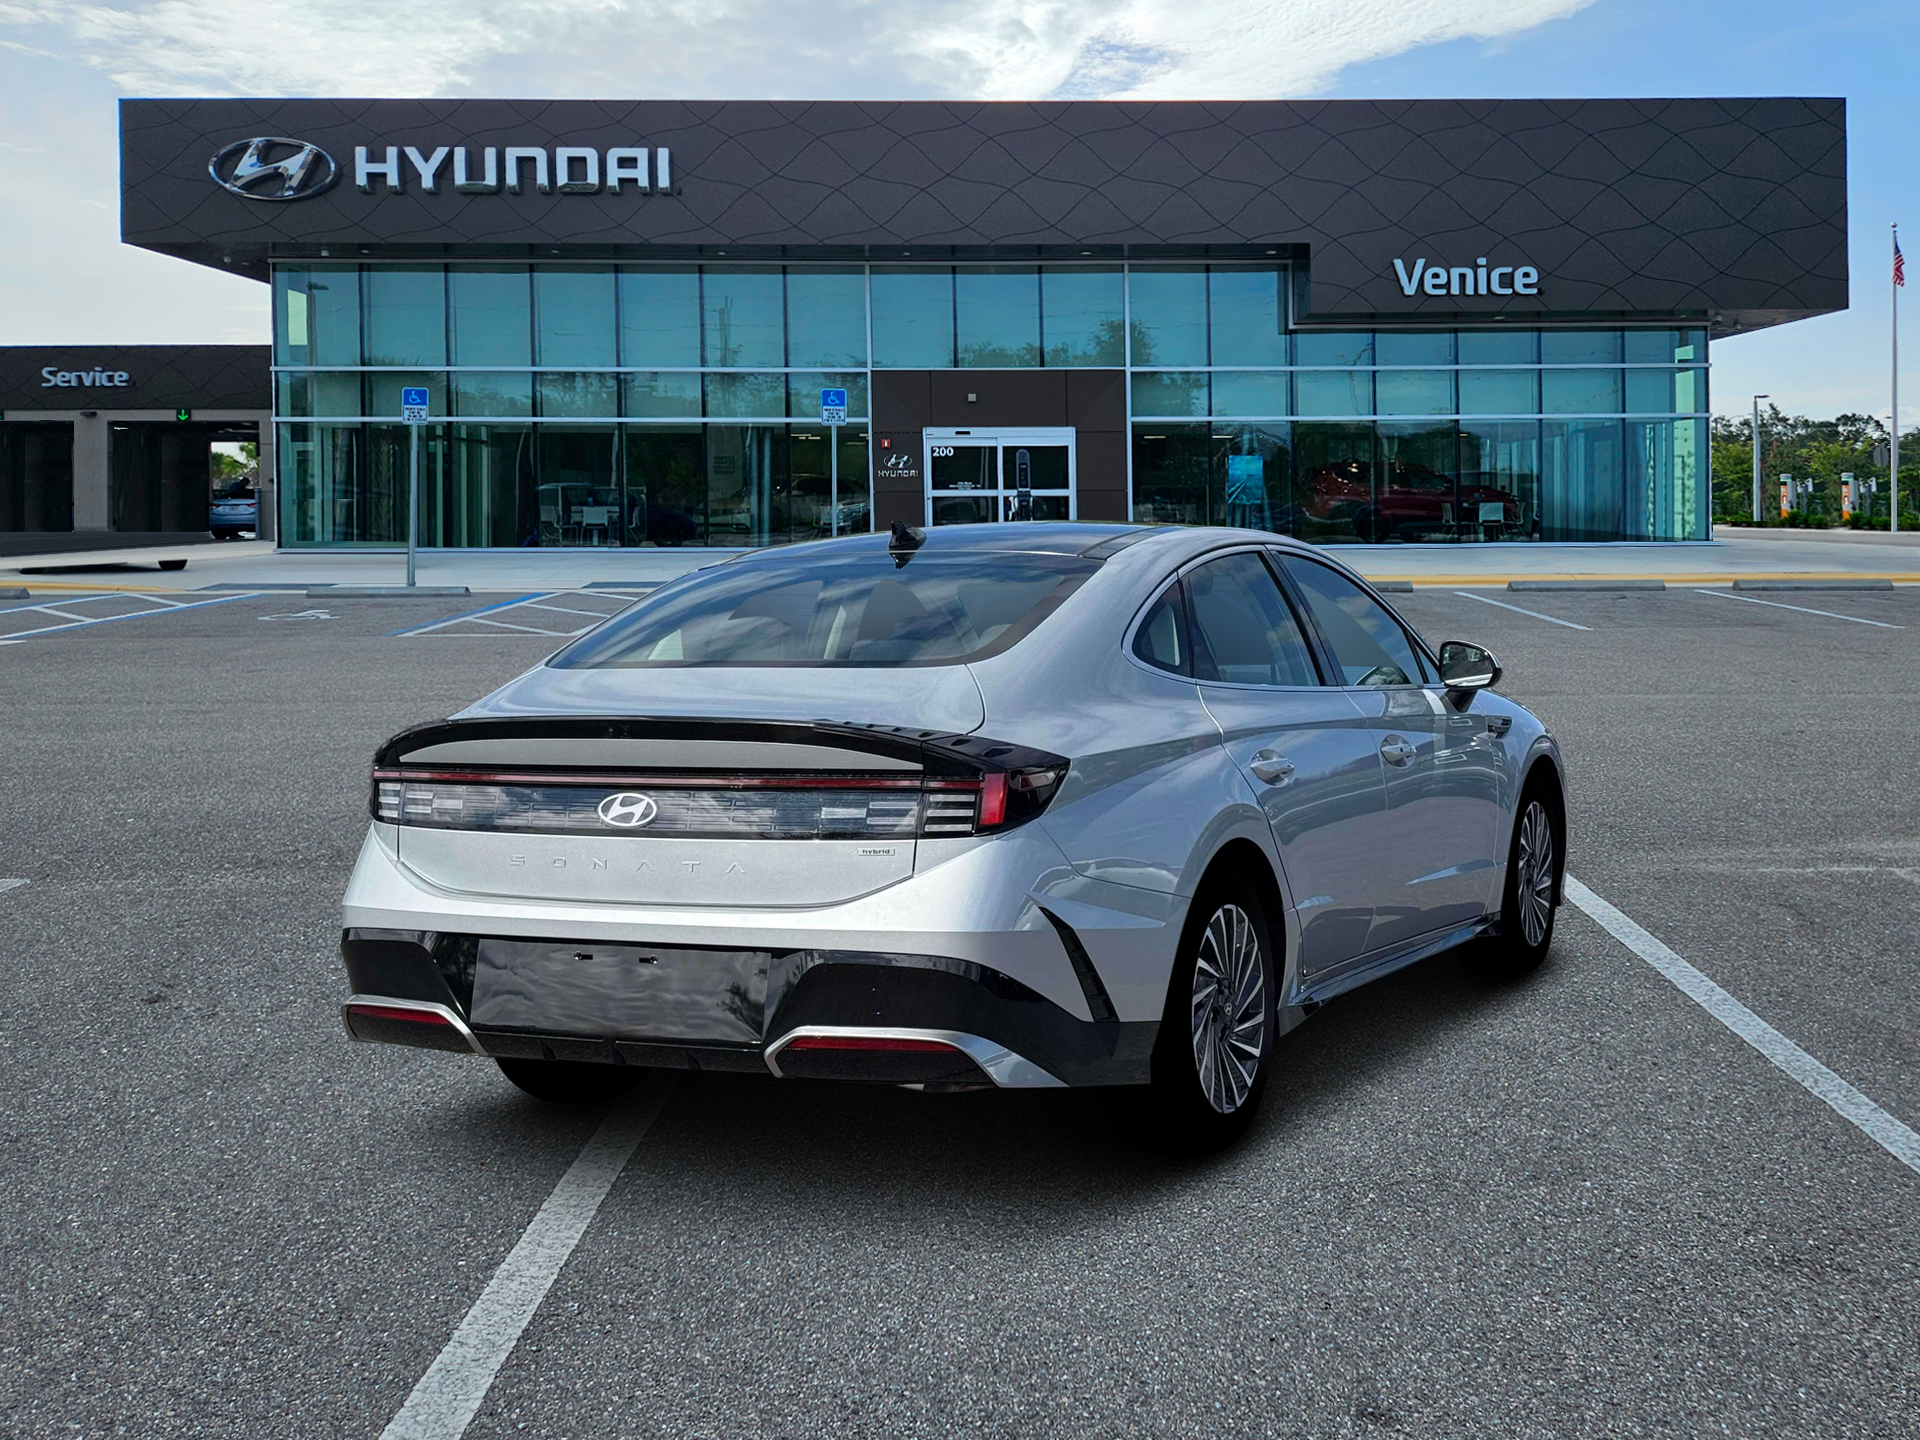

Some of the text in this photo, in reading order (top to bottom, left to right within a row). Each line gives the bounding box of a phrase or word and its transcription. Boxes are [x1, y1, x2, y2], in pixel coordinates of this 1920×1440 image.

[354, 145, 673, 194] HYUNDAI
[1392, 257, 1539, 296] Venice
[41, 366, 130, 388] Service
[932, 446, 954, 457] 200
[877, 469, 919, 478] HYUNDAI
[510, 854, 746, 874] SONATA
